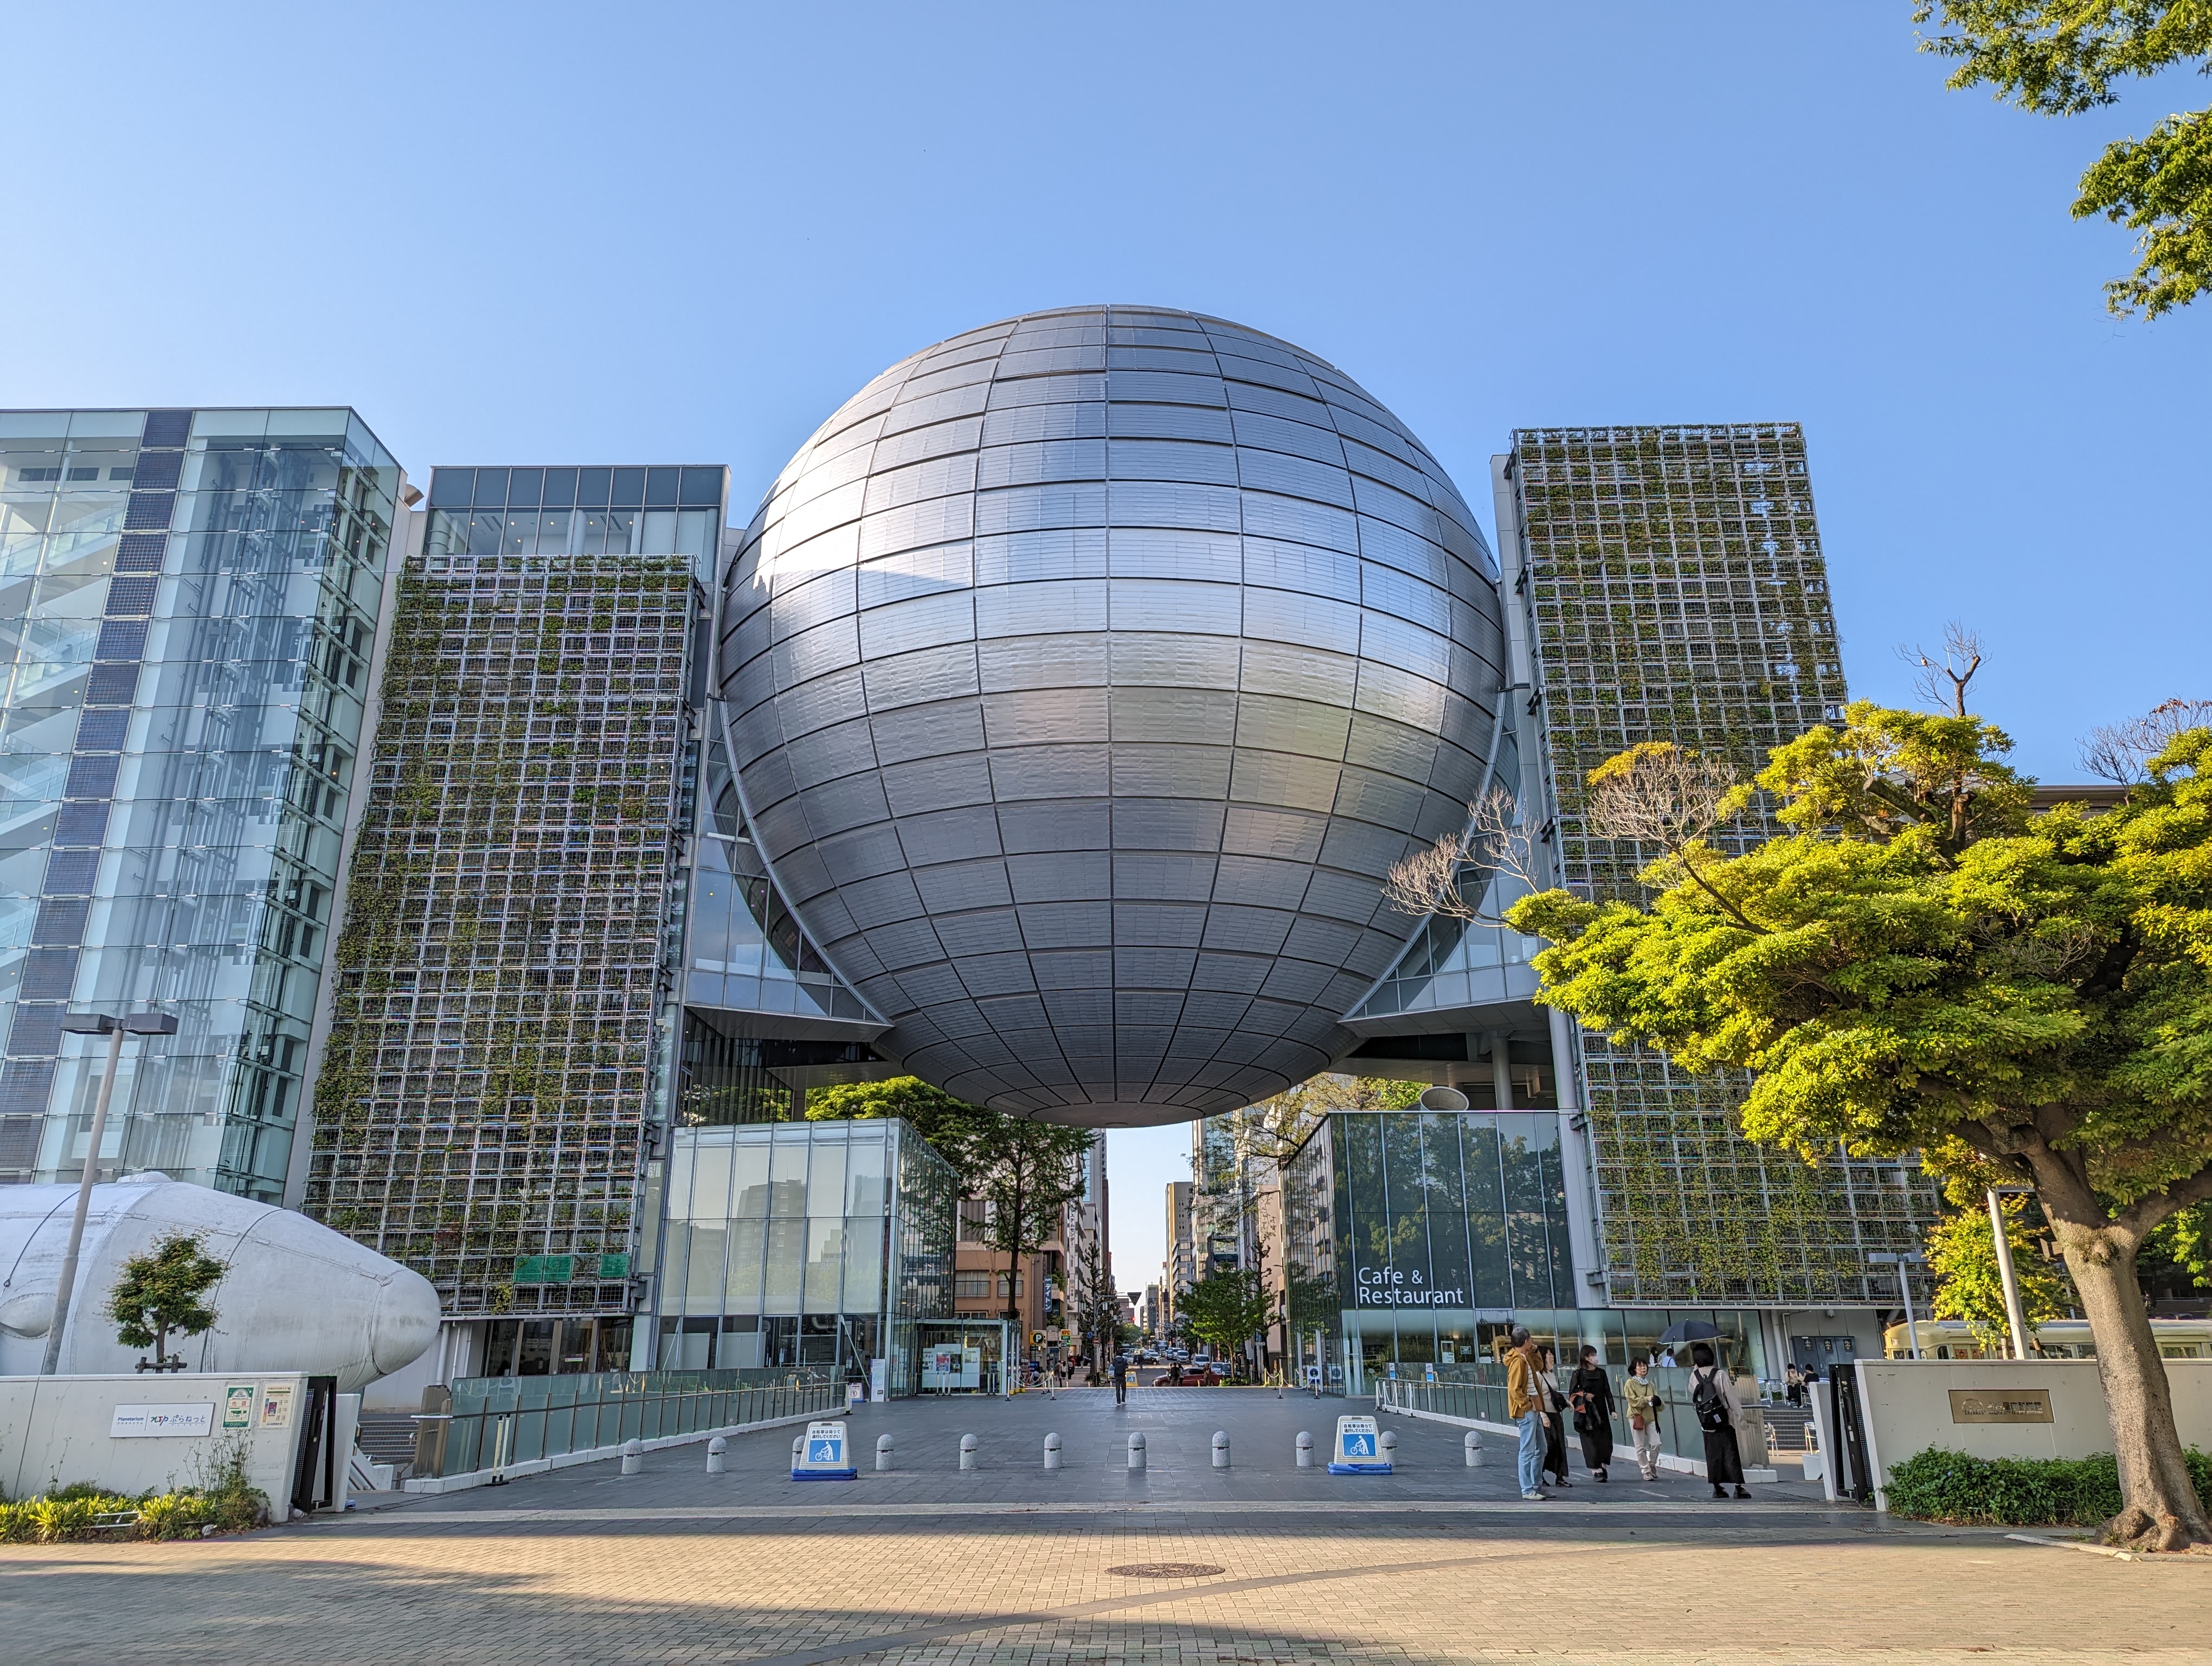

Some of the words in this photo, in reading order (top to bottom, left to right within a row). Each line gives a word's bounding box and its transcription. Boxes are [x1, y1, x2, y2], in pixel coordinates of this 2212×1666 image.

[1358, 1266, 1404, 1285] Cafe
[1411, 1270, 1423, 1285] &
[1359, 1286, 1464, 1304] Restaurant
[1036, 1334, 1042, 1343] P
